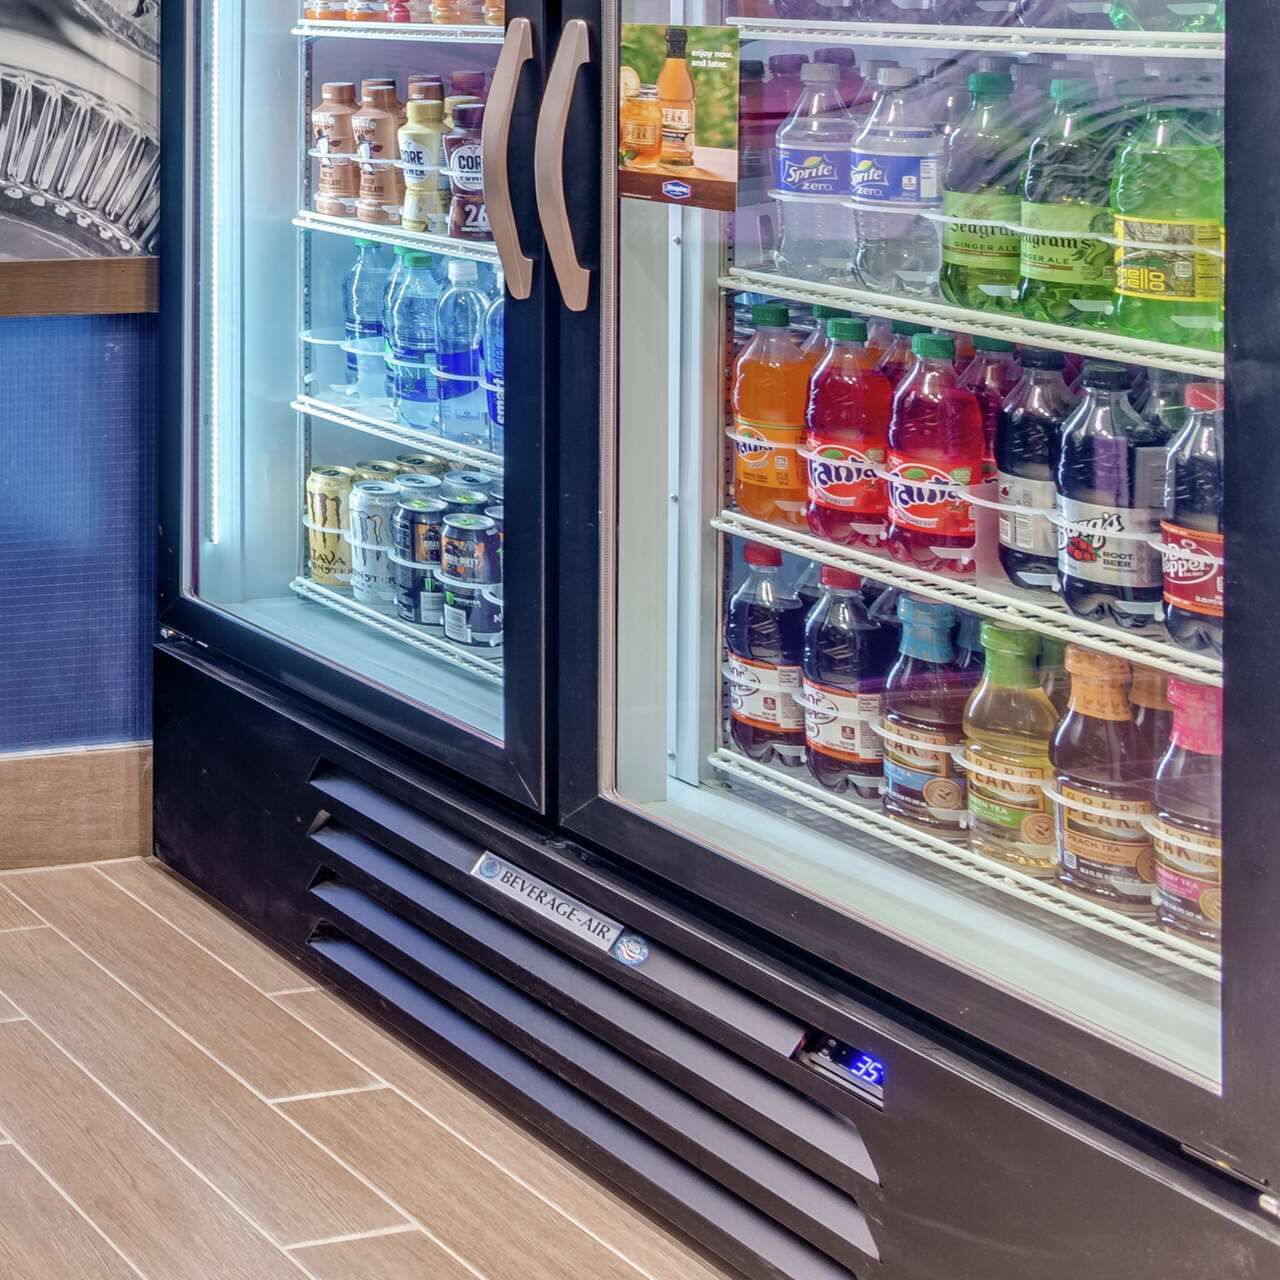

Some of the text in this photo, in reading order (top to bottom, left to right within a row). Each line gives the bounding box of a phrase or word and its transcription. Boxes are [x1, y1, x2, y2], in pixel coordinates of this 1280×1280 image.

[690, 49, 734, 60] enjoy now.
[691, 60, 728, 68] and later.
[458, 155, 483, 170] COR
[787, 164, 833, 185] Sprite
[851, 167, 883, 187] Sprite
[802, 182, 833, 192] zero
[857, 186, 882, 196] zero
[954, 240, 1018, 252] GINGER ALE
[311, 548, 346, 567] JAVA
[1103, 551, 1133, 561] ROOT
[1103, 559, 1132, 569] BEER
[1066, 791, 1131, 812] GOLD
[1101, 844, 1122, 854] TEA
[500, 870, 612, 941] BEVERAGE-AIR
